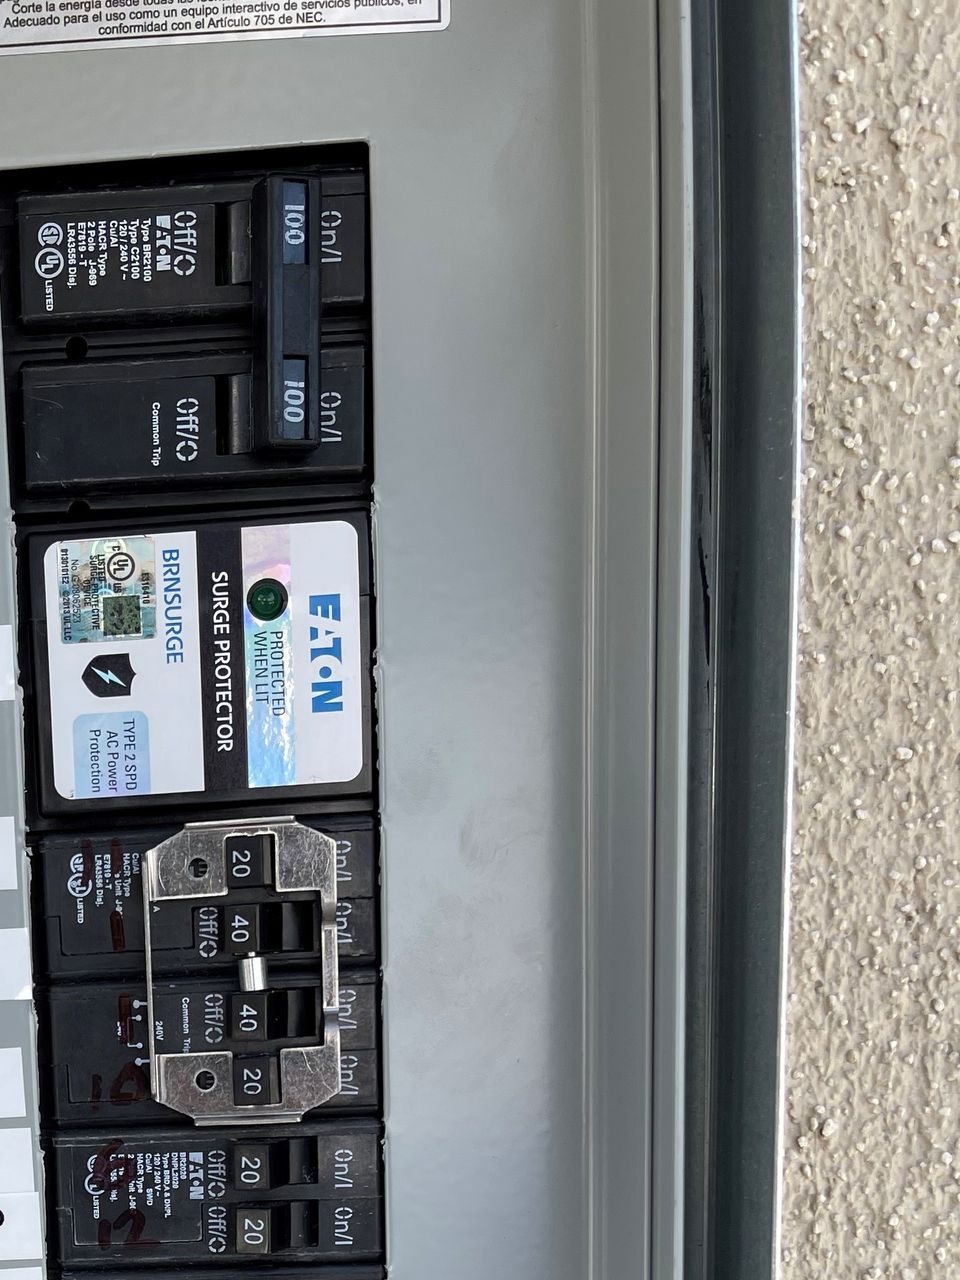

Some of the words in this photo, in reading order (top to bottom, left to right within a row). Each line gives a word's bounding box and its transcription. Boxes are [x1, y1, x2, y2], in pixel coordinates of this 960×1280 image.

[3, 16, 61, 28] Adecuado
[63, 14, 89, 26] para
[92, 11, 102, 22] el
[105, 12, 126, 21] uso
[131, 10, 160, 20] como
[164, 9, 178, 18] un
[181, 6, 218, 18] equipo
[222, 2, 281, 15] interactivo
[284, 0, 298, 11] de
[301, 0, 351, 10] servicios
[12, 3, 42, 14] Corte
[46, 1, 56, 11] la
[98, 21, 168, 36] conformidad
[171, 20, 191, 31] con
[194, 18, 205, 29] el
[207, 14, 251, 28] Artículo
[254, 15, 275, 26] 705
[278, 13, 293, 24] de
[296, 11, 326, 23] NEC.
[77, 222, 87, 252] E7819
[98, 221, 107, 250] HACR
[109, 220, 119, 247] Cu/Al
[119, 220, 128, 237] 120
[129, 219, 140, 244] Type
[141, 218, 152, 242] Type
[284, 204, 305, 245] 100
[67, 223, 76, 264] LR43556
[87, 230, 97, 251] Pole
[119, 245, 128, 262] 240
[98, 252, 108, 277] Type
[130, 247, 140, 279] C2100
[143, 244, 152, 282] BR2100
[44, 279, 54, 311] LISTED
[283, 380, 305, 423] 100
[151, 402, 161, 443] Common
[151, 447, 161, 467] Trip
[91, 584, 100, 630] PROTECTIVE
[162, 549, 184, 664] BRNSURGE
[211, 571, 230, 635] SURGE
[253, 631, 268, 679] WHEN
[309, 593, 344, 713] EATON
[269, 631, 286, 717] PROTECTED
[214, 639, 234, 753] PROTECTOR
[255, 683, 269, 704] LIT
[106, 730, 118, 748] AC
[123, 719, 136, 746] TYPE
[89, 729, 101, 794] Protection
[124, 750, 136, 758] 2
[107, 753, 118, 793] Power
[124, 763, 137, 791] SPD
[233, 850, 251, 878] 20
[230, 914, 249, 943] 40
[239, 1004, 257, 1032] 40
[243, 1068, 262, 1095] 20
[241, 1156, 261, 1184] 20
[244, 1218, 264, 1245] 20
